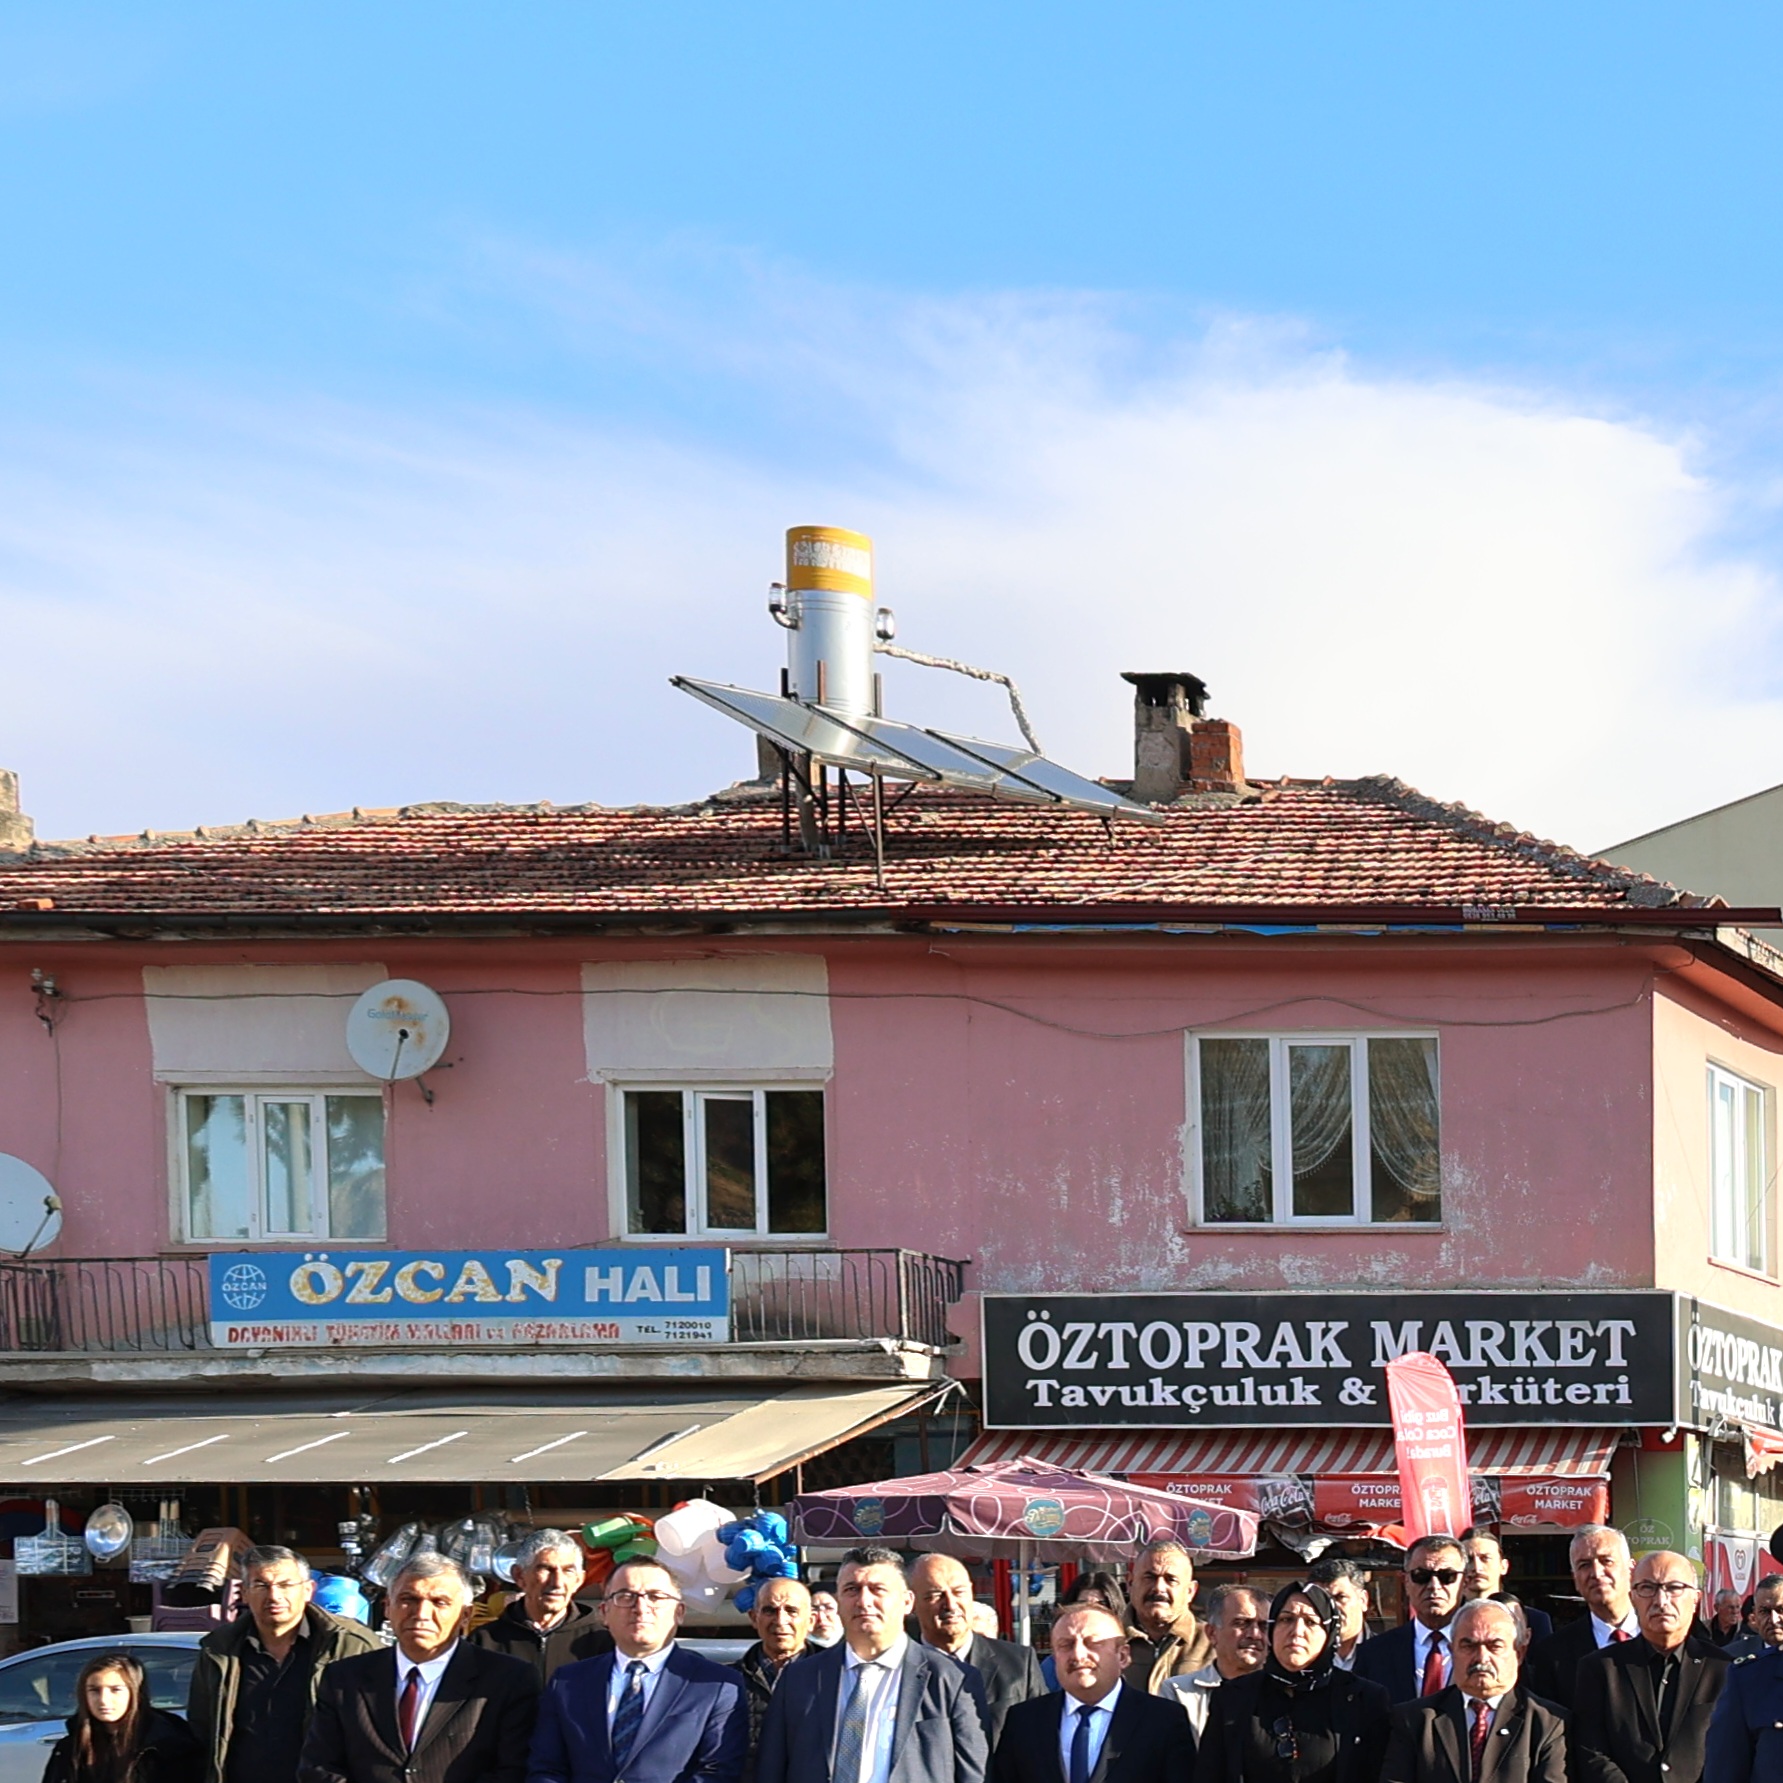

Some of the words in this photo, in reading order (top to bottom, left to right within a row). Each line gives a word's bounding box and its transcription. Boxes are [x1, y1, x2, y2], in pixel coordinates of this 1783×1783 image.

[290, 1253, 563, 1305] ÖZCAN
[585, 1266, 711, 1302] HALI
[665, 1321, 711, 1329] 7120010
[665, 1331, 712, 1339] 7121941
[1018, 1310, 1352, 1371] ÖZTOPRAK
[1370, 1320, 1637, 1368] MARKET
[1687, 1311, 1783, 1395] ÖZTOPRAK
[1026, 1377, 1322, 1414] Tavukçuluk
[1339, 1378, 1377, 1405] &
[1457, 1376, 1633, 1406] rküteri
[1166, 1482, 1232, 1494] ÖZTOPRAK
[1351, 1483, 1400, 1494] ÖZTOPR
[1526, 1485, 1592, 1497] ÖZTOPRAK
[1359, 1498, 1401, 1508] MARKE
[1535, 1500, 1583, 1510] MARKET
